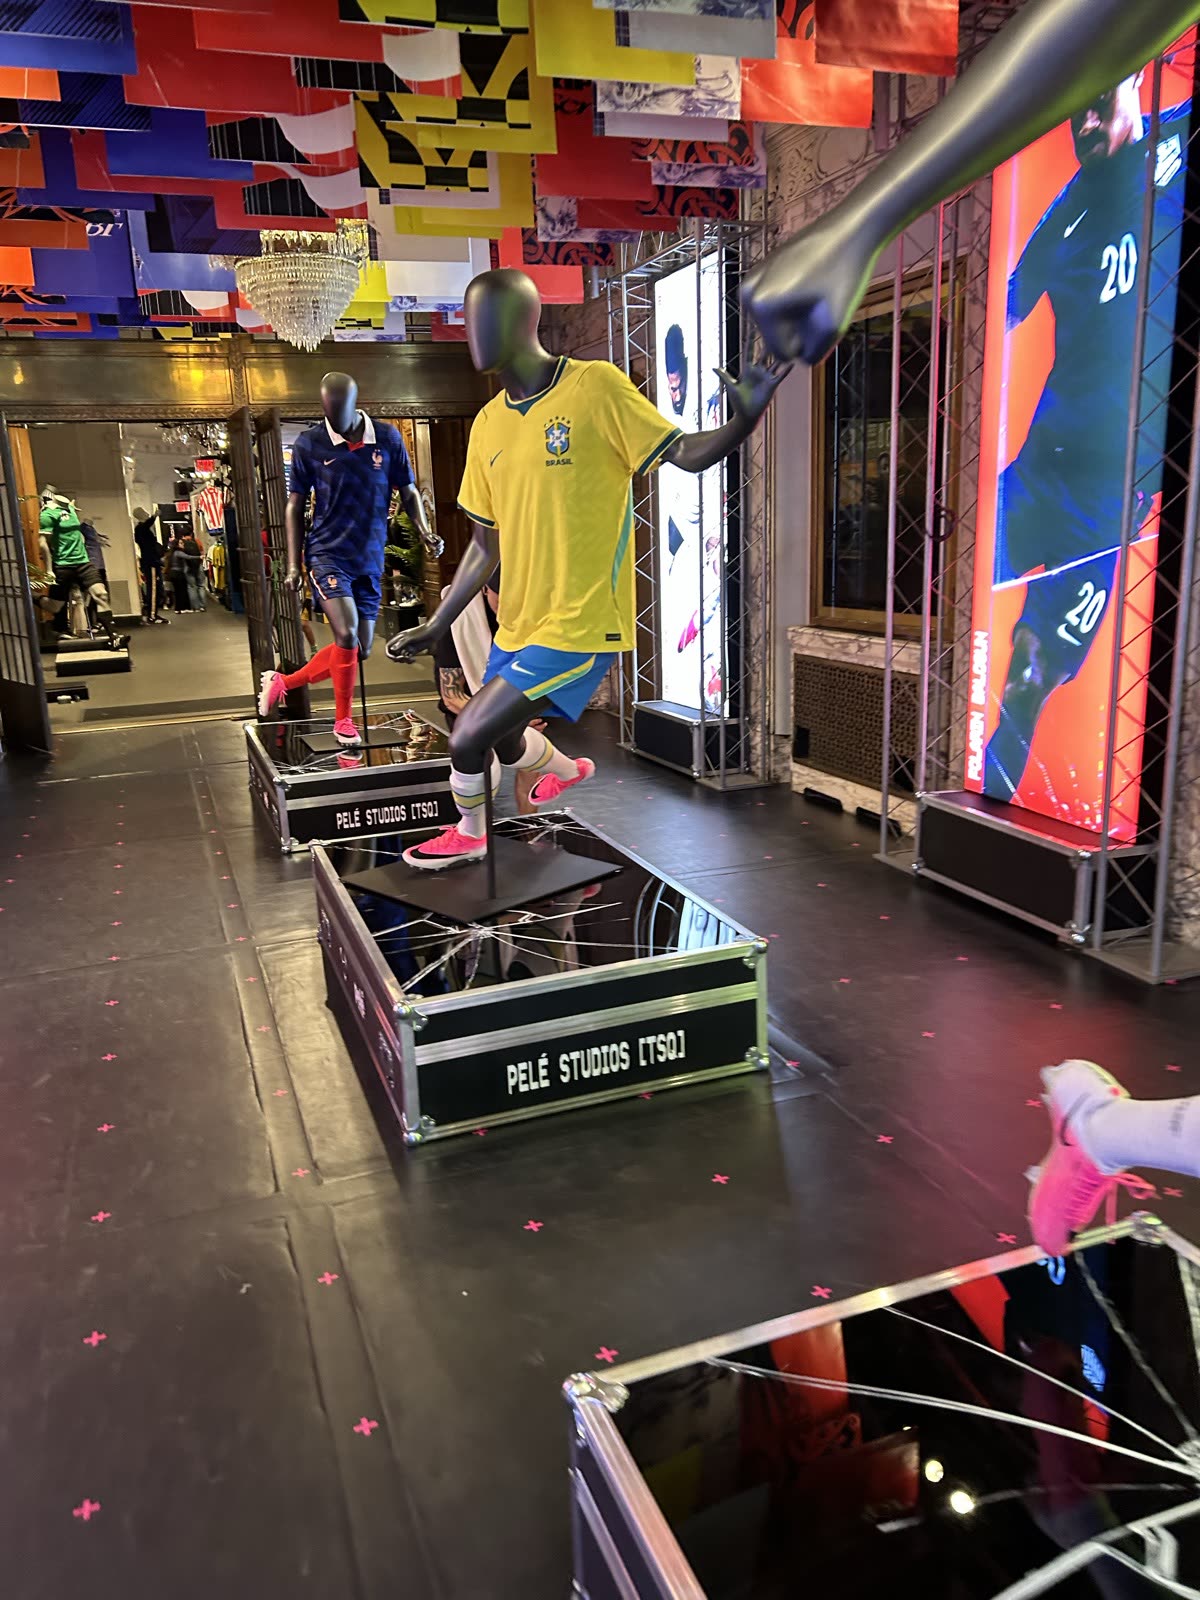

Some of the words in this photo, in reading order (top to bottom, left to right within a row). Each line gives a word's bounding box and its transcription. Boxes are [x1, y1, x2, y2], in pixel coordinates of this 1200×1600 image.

[1099, 232, 1138, 304] 20
[545, 458, 573, 467] BRASIL
[1064, 581, 1107, 634] 20
[336, 808, 361, 830] PELÉ
[365, 805, 407, 826] STUDIOS
[411, 801, 439, 820] [TSQ]
[507, 1053, 550, 1095] PELÉ
[558, 1041, 630, 1083] STUDIOS
[638, 1029, 686, 1067] [TSQ]
